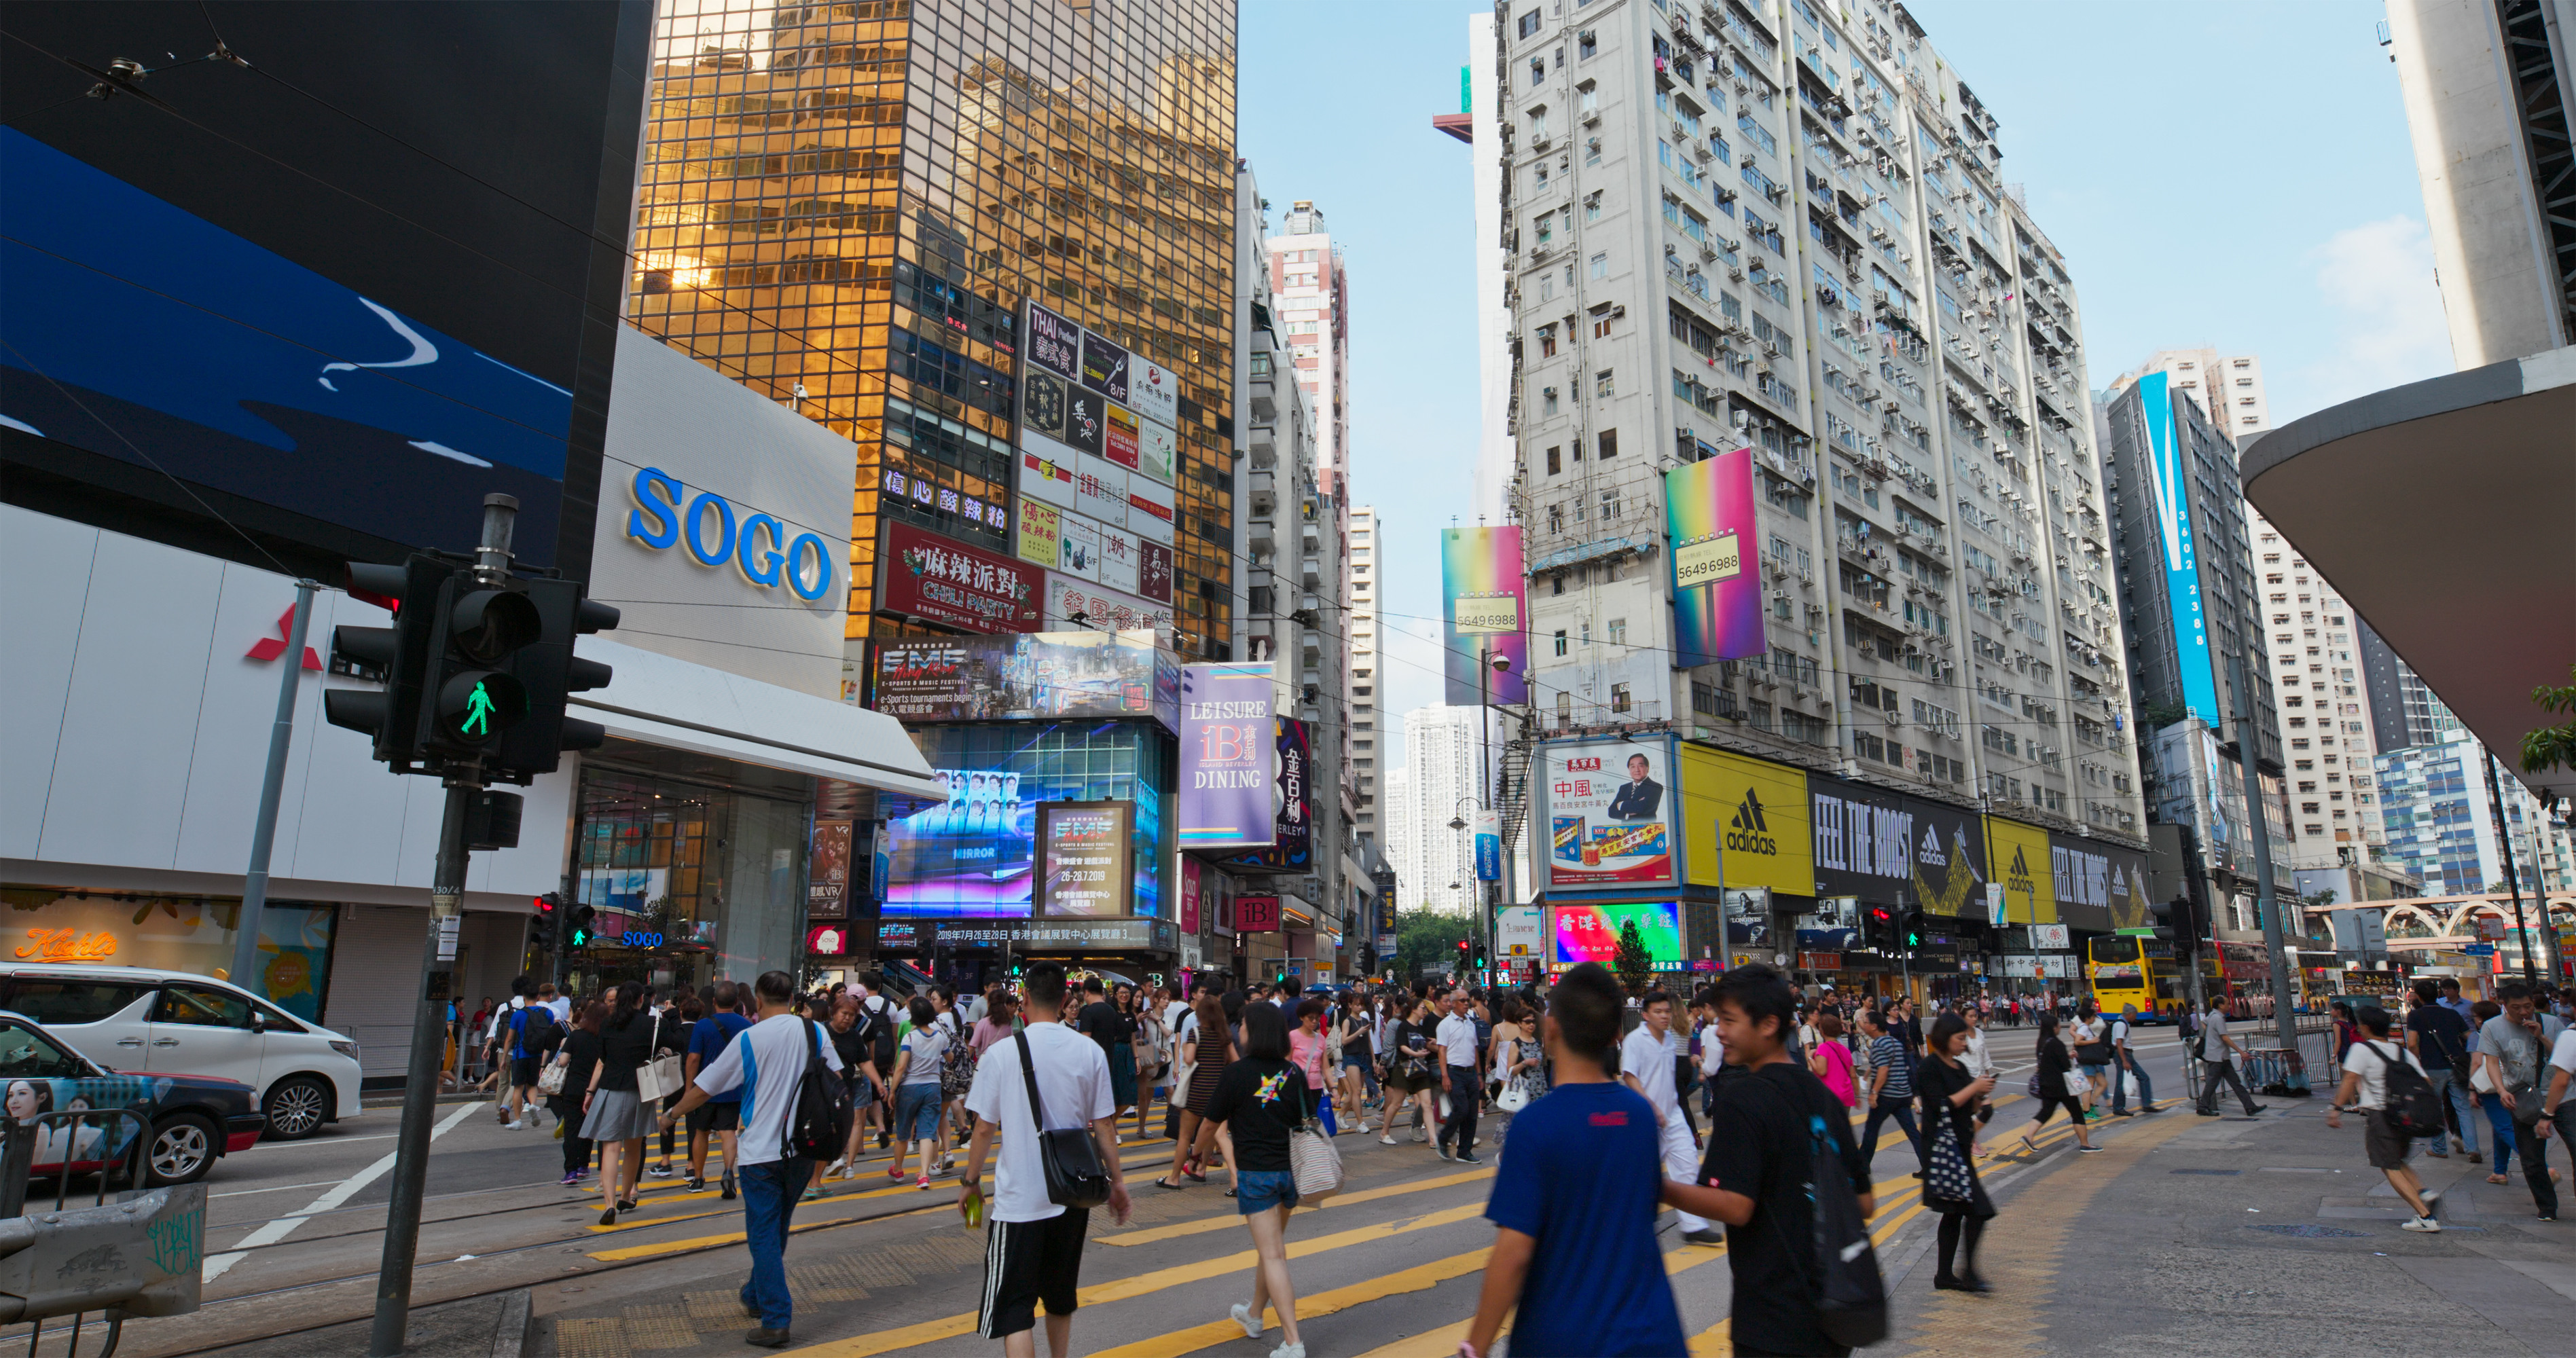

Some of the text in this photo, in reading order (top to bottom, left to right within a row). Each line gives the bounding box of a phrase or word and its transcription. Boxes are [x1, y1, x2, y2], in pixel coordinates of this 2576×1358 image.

[1032, 308, 1076, 346] THAI Perfect
[994, 340, 1014, 354] PERFECT
[1036, 336, 1070, 372] 泰式食
[1110, 383, 1127, 399] 8/F
[1132, 401, 1142, 409] 8/F
[885, 471, 1004, 529] 傷心酸辣粉
[1023, 502, 1056, 525] 傷心
[627, 467, 831, 600] SOGO
[1021, 522, 1056, 542] 酸辣粉
[1087, 557, 1097, 566] 5/F
[1679, 555, 1738, 579] 5649 6988
[924, 547, 1018, 599] 麻辣派對
[923, 581, 1015, 621] CHILI PARTY
[1457, 614, 1516, 626] 5649 6988
[884, 649, 967, 673] EMF
[893, 662, 923, 680] Hong
[881, 693, 972, 703] e-Sports tournaments begin
[880, 704, 933, 714] 投入電競盛會
[1191, 701, 1266, 720] LEISURE
[1200, 724, 1243, 762] iB
[1244, 724, 1257, 761] 金百利
[1195, 770, 1261, 789] DINING
[1285, 748, 1302, 823] 金百利
[1555, 779, 1593, 799] 中風
[1553, 799, 1609, 809] 馬百良安宮牛黃丸
[1056, 822, 1114, 838] EMF
[1277, 823, 1302, 837] ERLEY
[1815, 793, 1914, 879] FEEL THE BOOST
[1727, 830, 1776, 856] adidas
[953, 847, 995, 860] MIRROR
[1919, 850, 1946, 866] adidas
[1061, 870, 1105, 881] 26-28.7.2019
[2008, 874, 2035, 894] adidas
[2052, 845, 2109, 907] FEEL THE BOOST
[1055, 891, 1110, 899] 香港會議展覽中心
[2112, 885, 2128, 896] adidas
[1244, 902, 1267, 923] iB
[623, 931, 663, 947] SOGO
[879, 927, 915, 937] EMF
[937, 930, 1008, 940] 2019年7月26至28日
[1011, 928, 1120, 941] 香港會議展覽中心展覽廳
[1123, 929, 1127, 939] 3
[15, 928, 117, 961] Kiehl's
